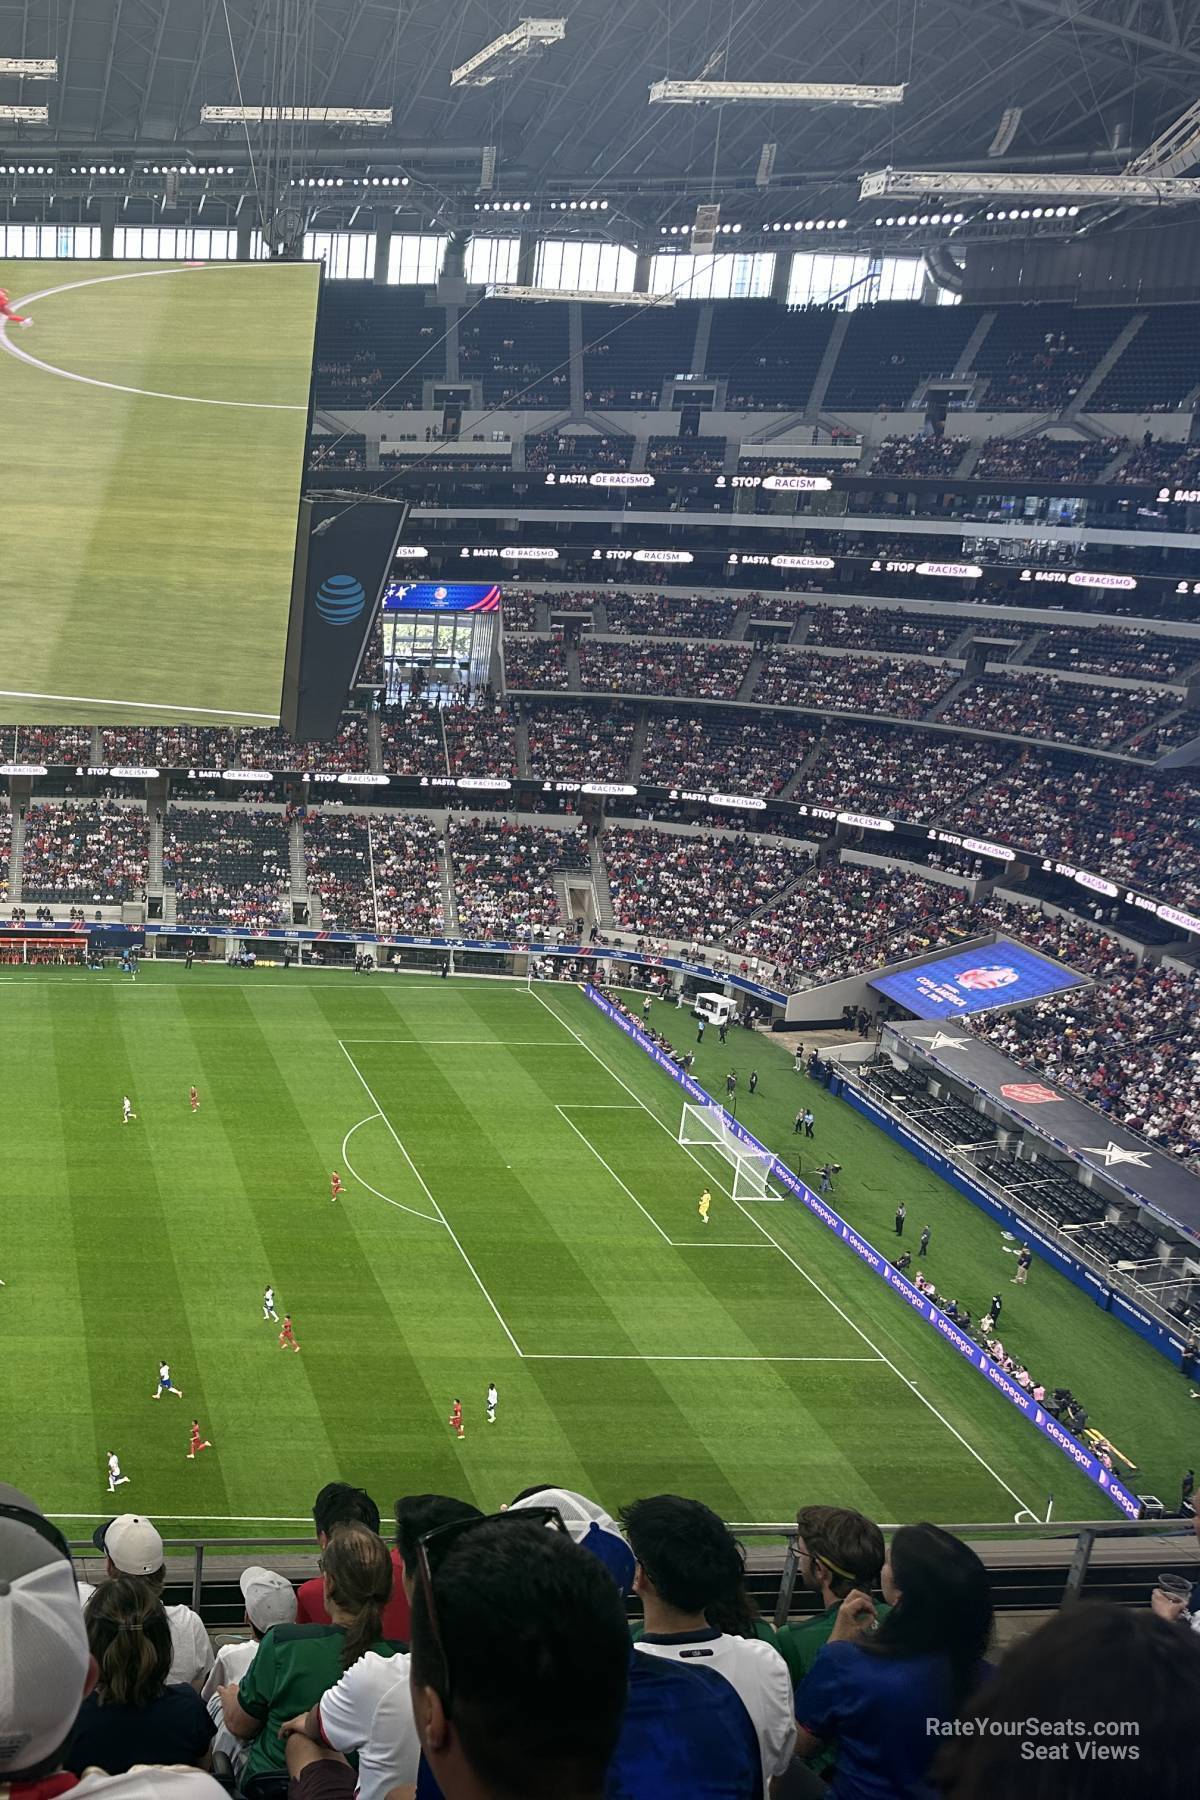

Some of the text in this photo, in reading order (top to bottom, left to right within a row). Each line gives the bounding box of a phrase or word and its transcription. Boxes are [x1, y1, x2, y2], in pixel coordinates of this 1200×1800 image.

[560, 475, 588, 484] BASTA
[731, 476, 815, 488] STOP RACISM
[606, 550, 632, 559] STOP
[742, 555, 769, 564] BASTA
[886, 562, 967, 574] STOP RACISM
[1035, 572, 1066, 582] BASTA
[1089, 576, 1130, 586] RACISMO
[556, 783, 580, 791] STOP
[682, 792, 707, 802] BASTA
[812, 808, 880, 826] STOP RACISM
[939, 833, 961, 846] BASTA
[978, 844, 1011, 858] RACISMO
[1055, 864, 1076, 877] STOP
[810, 1199, 838, 1228] despegar
[849, 1236, 880, 1265] despegar
[891, 1274, 924, 1310] despegar
[938, 1318, 974, 1357] despegar
[989, 1368, 1029, 1410] despegar
[1046, 1422, 1092, 1469] despegar
[1110, 1484, 1139, 1520] despe
